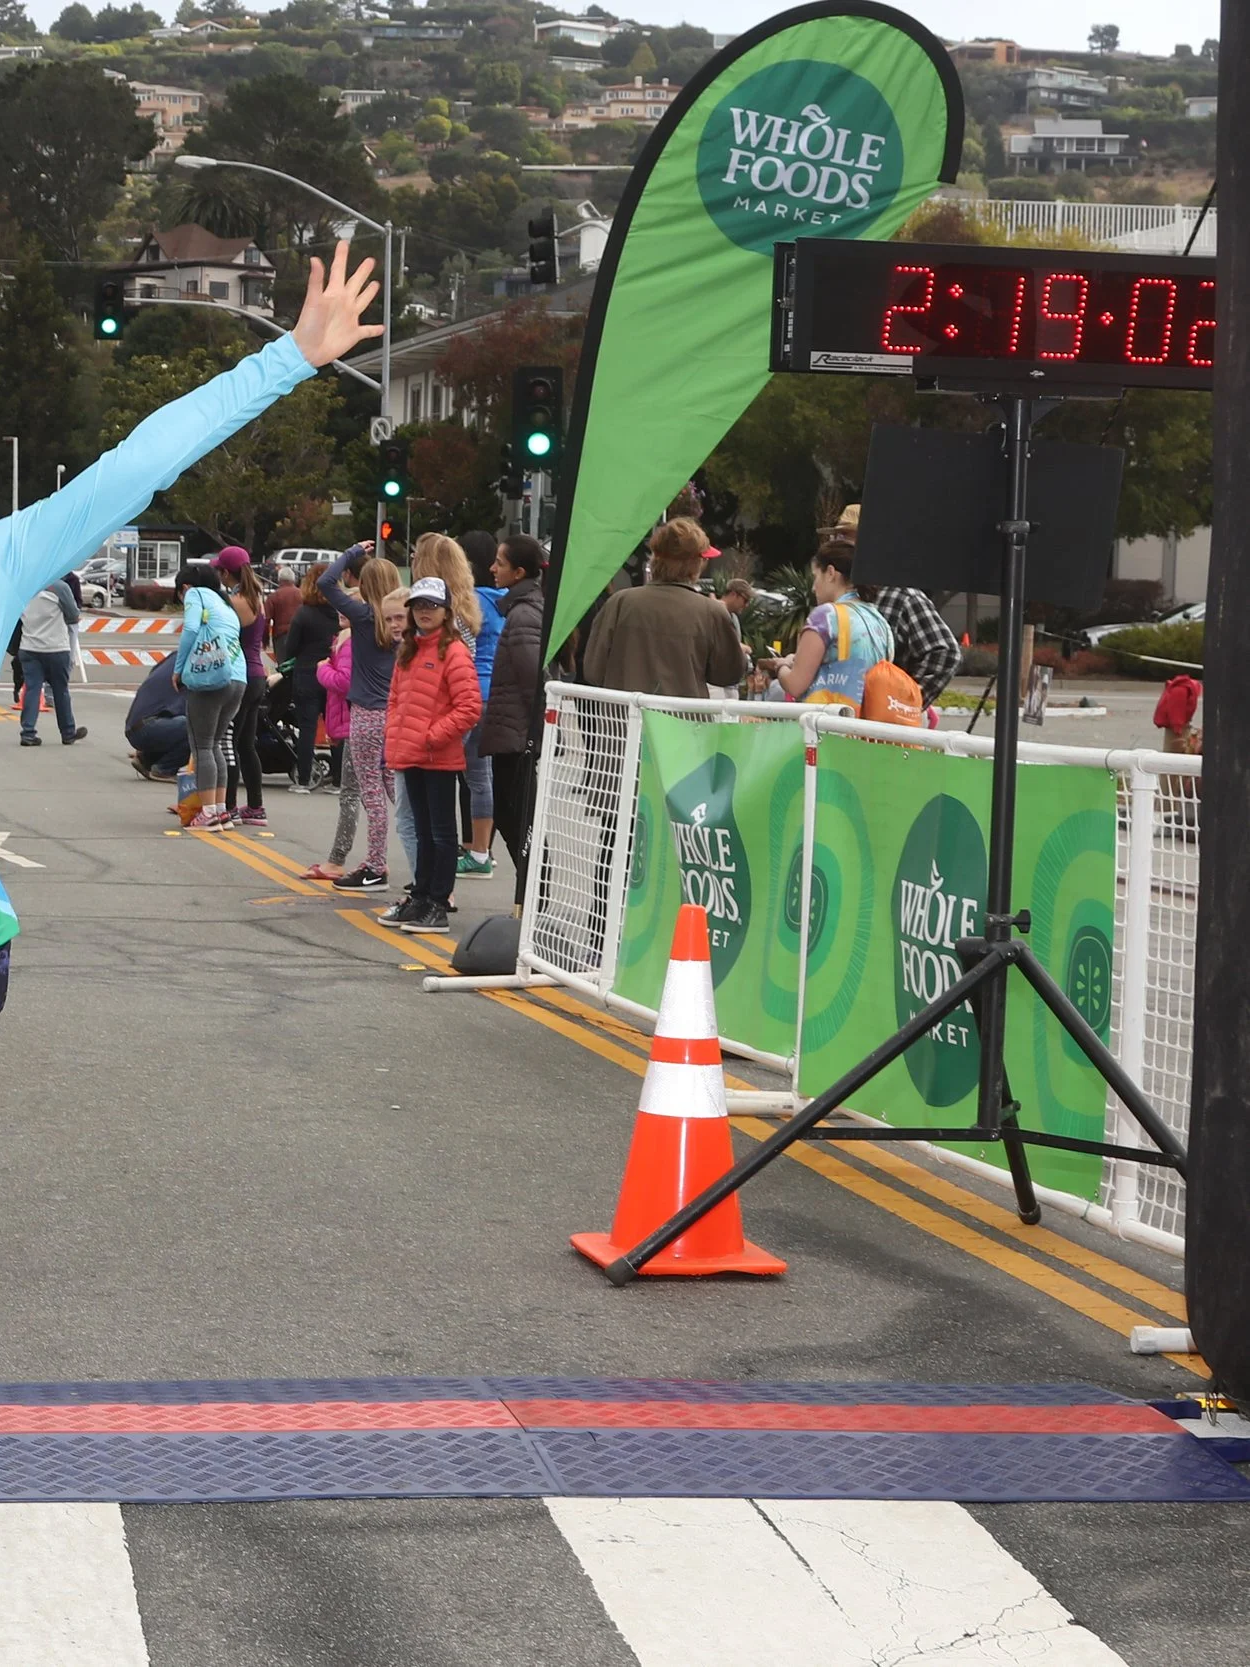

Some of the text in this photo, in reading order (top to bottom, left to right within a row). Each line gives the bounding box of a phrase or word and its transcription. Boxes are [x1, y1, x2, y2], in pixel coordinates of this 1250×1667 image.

[730, 104, 886, 172] WHOLE
[722, 148, 874, 210] FOODS
[733, 196, 842, 225] MARKET
[810, 672, 849, 689] ARIN
[901, 878, 978, 950] WHOLE
